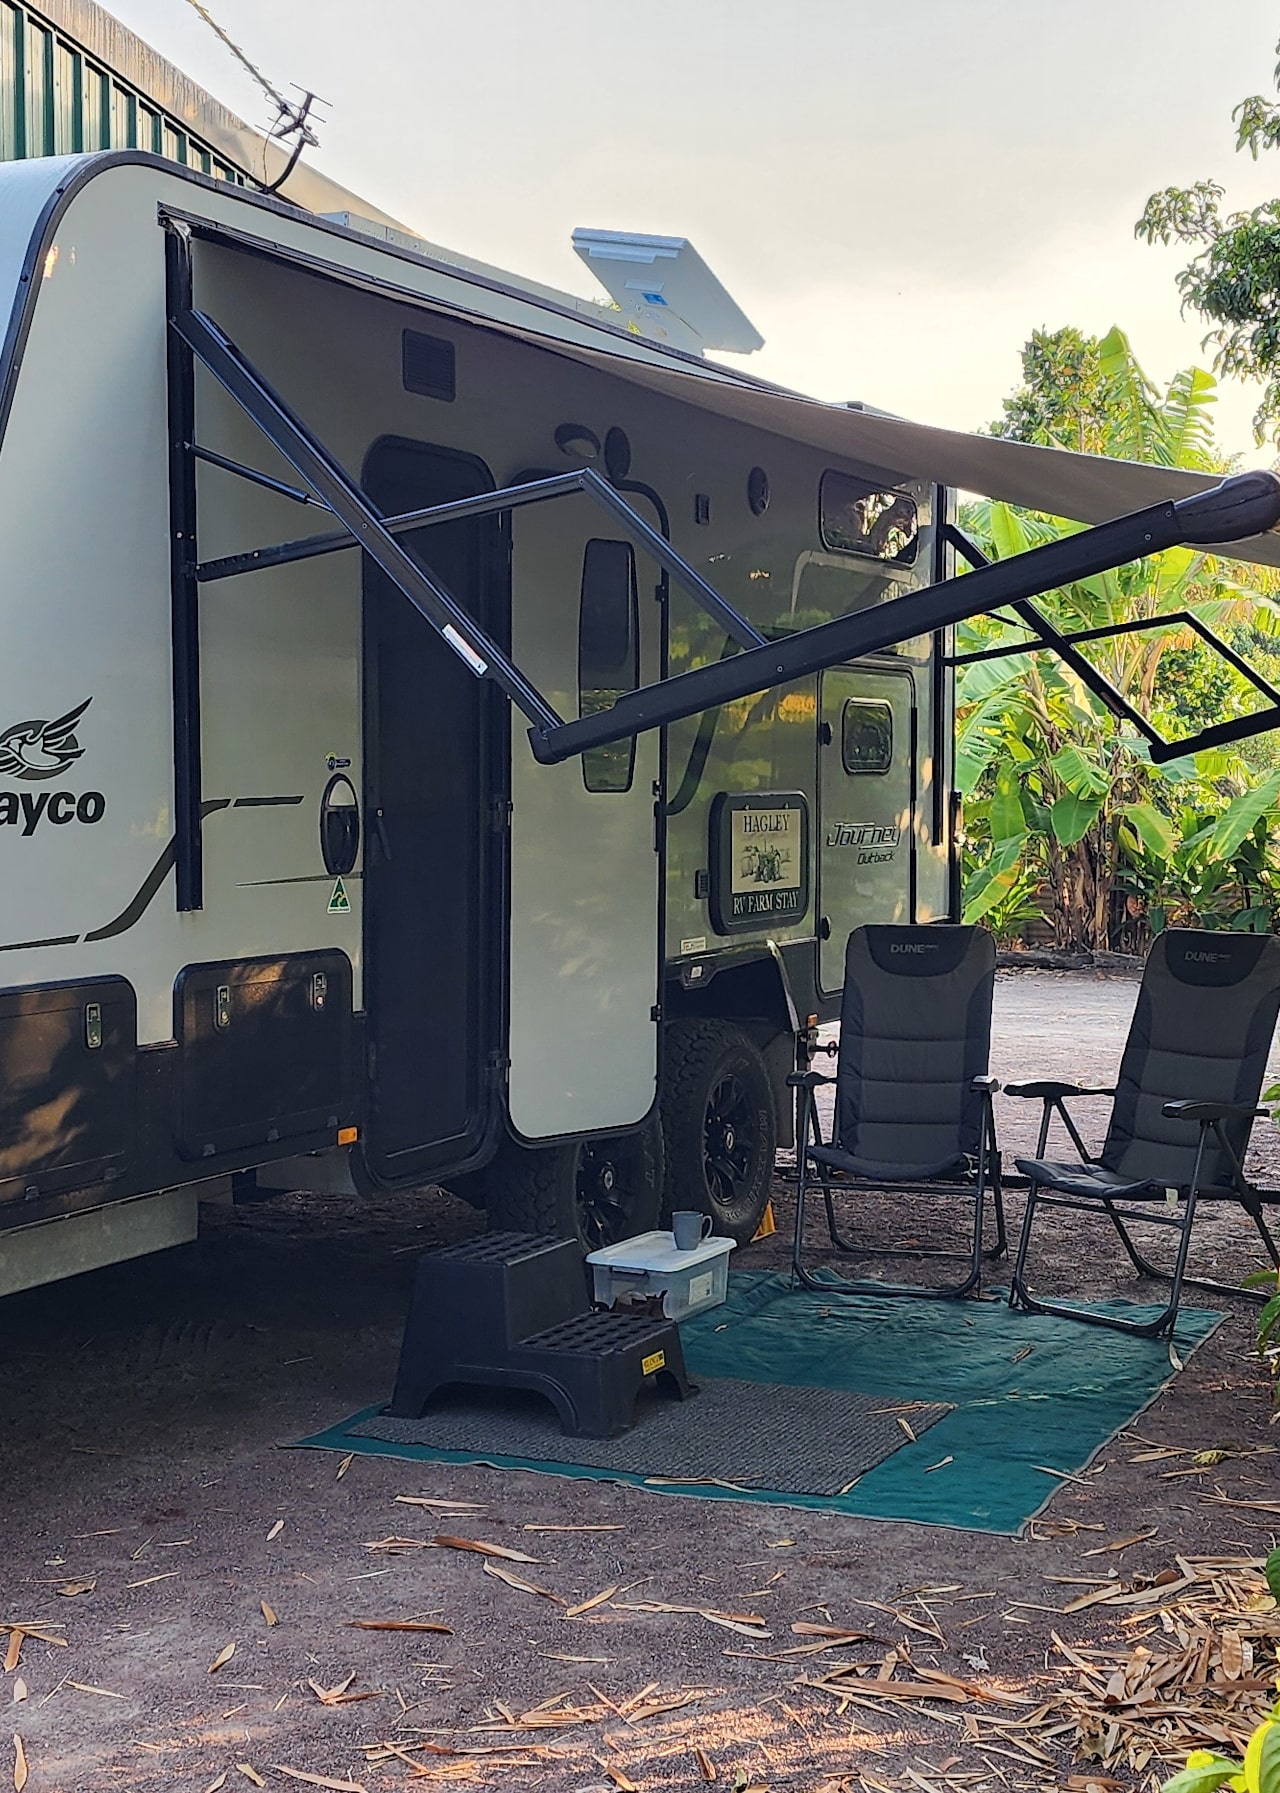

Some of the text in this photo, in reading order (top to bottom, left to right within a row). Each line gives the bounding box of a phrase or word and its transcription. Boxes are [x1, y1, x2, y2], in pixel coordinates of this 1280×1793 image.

[743, 814, 790, 833] HAGLEY
[827, 823, 901, 847] Journey
[857, 850, 895, 865] Outback
[733, 890, 800, 915] RV FARM STAY
[890, 943, 925, 954] DUNE
[1185, 950, 1218, 963] DUNE
